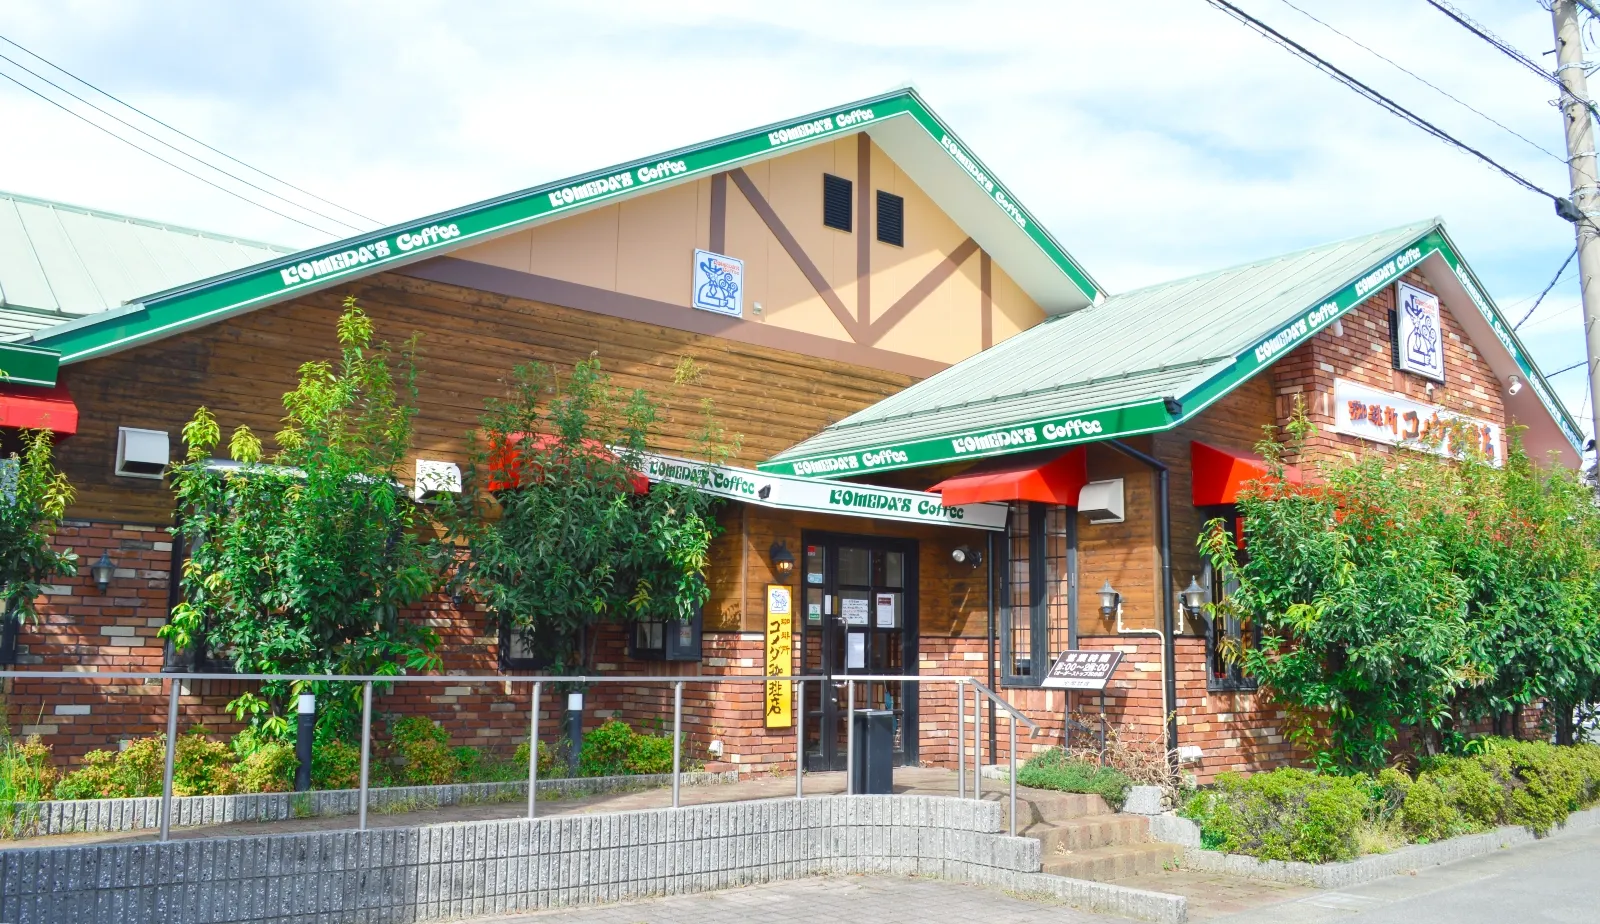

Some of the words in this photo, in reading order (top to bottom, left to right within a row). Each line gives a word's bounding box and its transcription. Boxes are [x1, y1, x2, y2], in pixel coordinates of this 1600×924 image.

[768, 117, 833, 146] KOMEDA'S
[836, 109, 874, 127] Coffee
[548, 172, 633, 207] KOMEDA'S
[637, 160, 687, 183] Coffee
[941, 134, 994, 193] KOMEDA'S
[995, 191, 1026, 228] Coffee
[279, 240, 391, 286] KOMEDA'S
[396, 223, 460, 251] Coffee
[1354, 260, 1396, 297] KOMEDA'S
[1396, 247, 1422, 269] Coffee
[1254, 319, 1308, 363] KOMEDA'S
[1308, 301, 1339, 327] Coffee
[952, 426, 1037, 454] KOMEDA'S
[1043, 418, 1103, 440] Coffee
[713, 471, 755, 495] Coffee
[792, 454, 858, 476] KOMEDA'S
[862, 449, 909, 467] Coffee
[829, 489, 912, 514] KOMEDA'S
